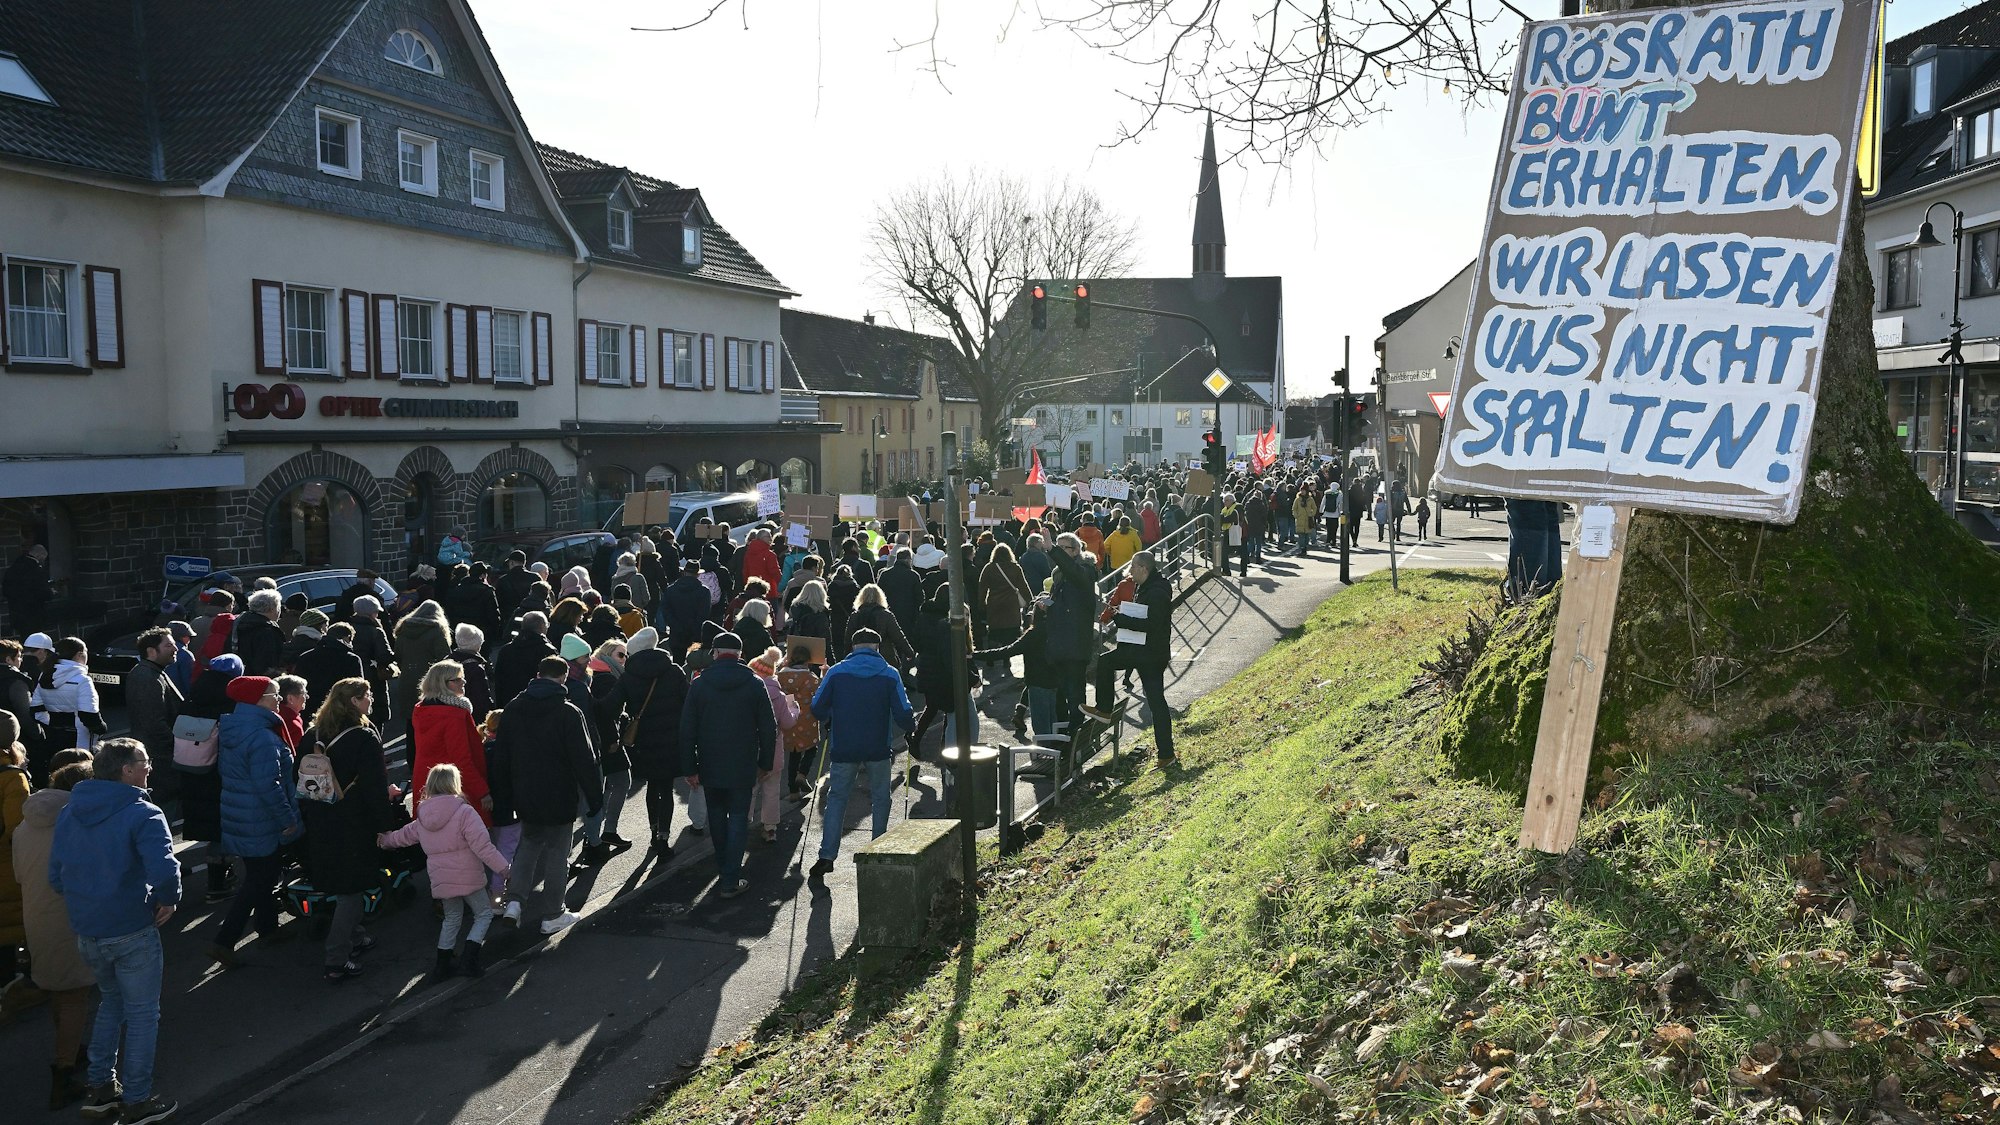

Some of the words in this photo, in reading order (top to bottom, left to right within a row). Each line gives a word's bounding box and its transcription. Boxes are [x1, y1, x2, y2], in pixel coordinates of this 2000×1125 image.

[1530, 8, 1836, 86] RÖSRATH
[1518, 90, 1686, 146] BUNT
[1508, 143, 1830, 208] ERHALTEN.
[1496, 236, 1593, 297] WIR
[1608, 240, 1834, 308] LASSEN
[1387, 371, 1419, 382] Bensberger
[1485, 314, 1595, 376] UNS
[1613, 323, 1815, 386] NICHT
[319, 396, 383, 417] OPTIK
[384, 398, 519, 418] GUMMERSBACH
[1462, 388, 1800, 483] SPALTEN!
